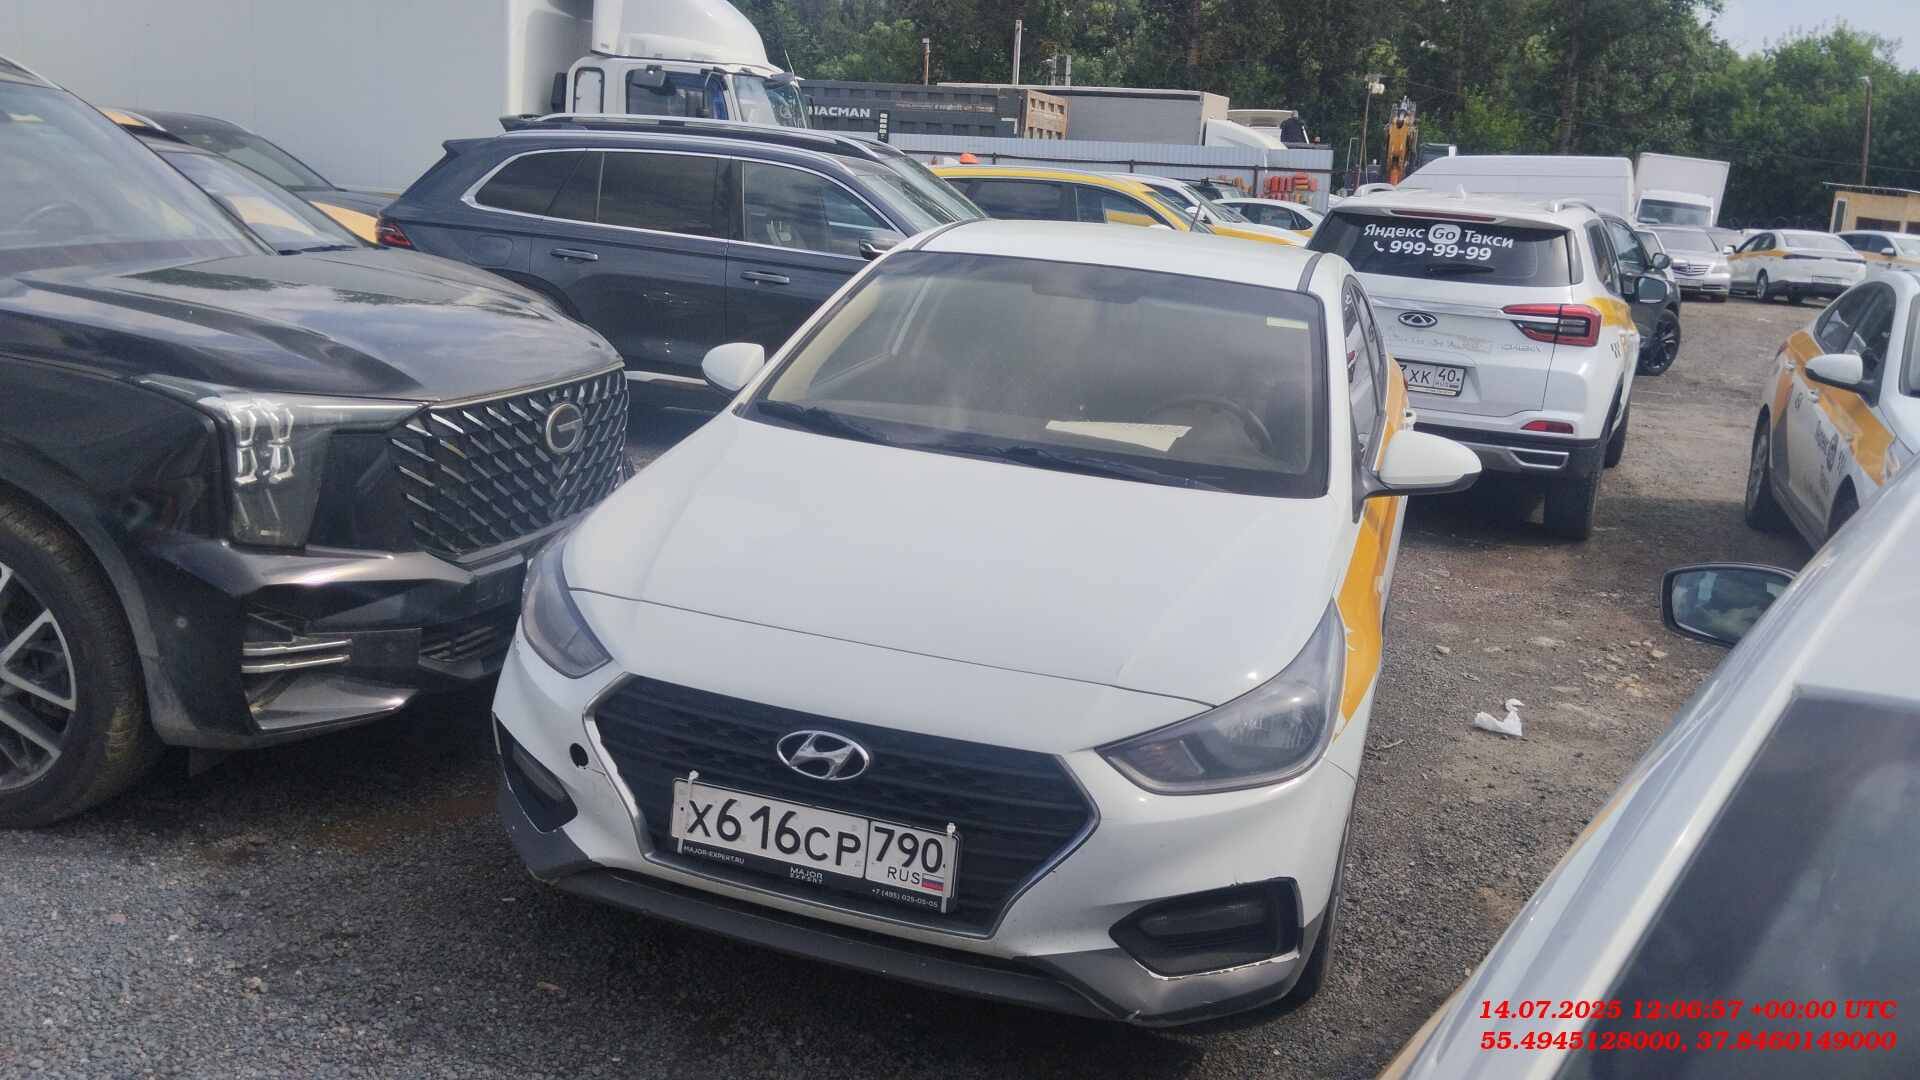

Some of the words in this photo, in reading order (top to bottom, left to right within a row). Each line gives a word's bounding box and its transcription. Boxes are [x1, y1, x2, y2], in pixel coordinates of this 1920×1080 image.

[1363, 223, 1425, 239] Яндекс
[1431, 226, 1458, 242] Go
[1465, 230, 1515, 249] Такси
[1389, 240, 1492, 261] 999-99-99
[874, 826, 944, 874] 790
[790, 866, 824, 880] MAJOR
[887, 866, 921, 885] RUS
